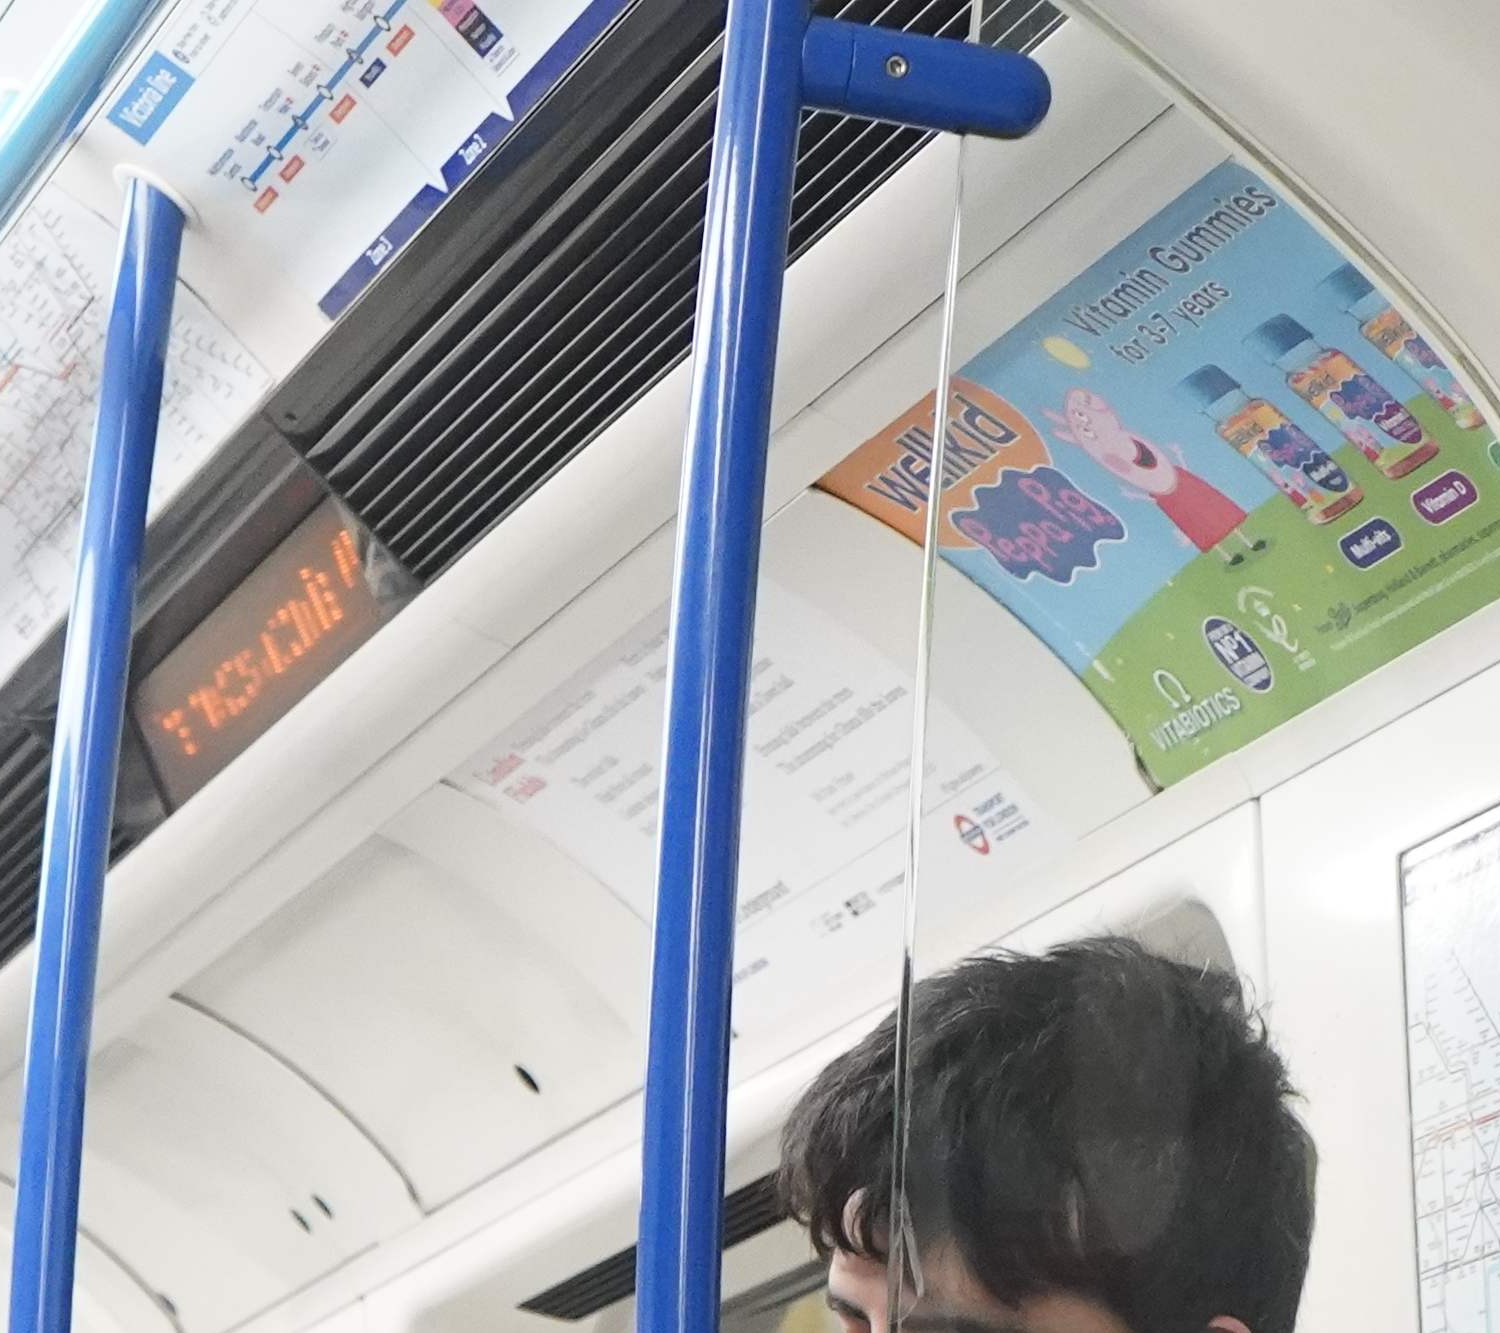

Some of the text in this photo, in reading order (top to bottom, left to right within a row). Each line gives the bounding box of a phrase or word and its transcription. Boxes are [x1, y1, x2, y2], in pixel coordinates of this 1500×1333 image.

[1063, 185, 1277, 337] Vitamin Gummies
[1108, 281, 1232, 366] for 3-7 years
[868, 393, 1015, 512] wellkid
[960, 478, 1107, 573] Peppa Pig
[1420, 487, 1459, 515] Vitamin
[1350, 529, 1393, 560] Multi-vits
[1149, 688, 1242, 750] VITABIOTICS
